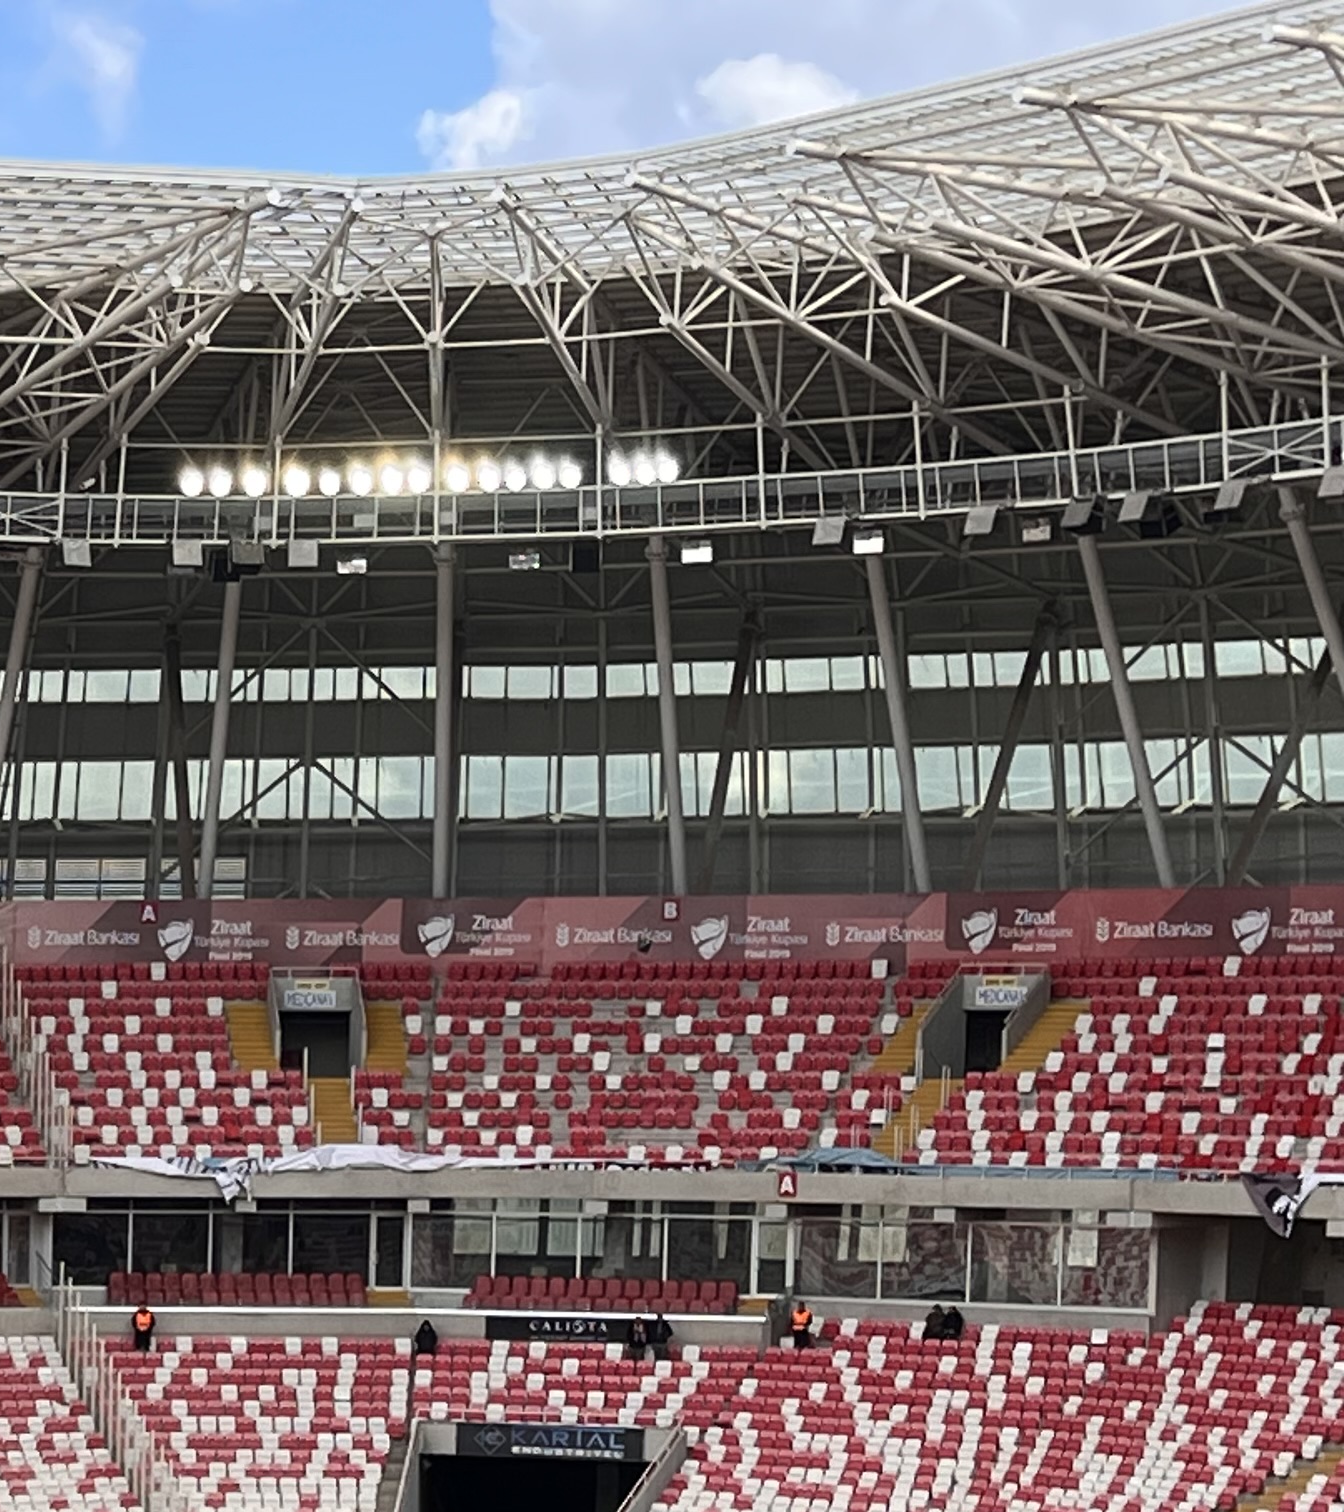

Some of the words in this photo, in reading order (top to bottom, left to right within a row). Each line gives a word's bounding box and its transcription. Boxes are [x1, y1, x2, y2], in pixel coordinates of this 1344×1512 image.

[141, 904, 156, 922] A
[663, 901, 678, 919] B
[1014, 908, 1057, 926] Ziraat
[1289, 908, 1335, 925] Ziraat
[210, 919, 252, 936] Ziraat
[471, 914, 514, 931] Ziraat
[747, 915, 791, 933] Ziraat
[1112, 920, 1155, 939] Ziraat
[1156, 920, 1213, 939] Bankası
[43, 929, 86, 947] Ziraat
[86, 929, 140, 947] Bankası
[303, 930, 344, 947] Ziraat
[345, 930, 401, 947] Bankası
[573, 927, 615, 944] Ziraat
[844, 925, 888, 943] Ziraat
[779, 1174, 795, 1195] A
[511, 1427, 625, 1450] KARTAL
